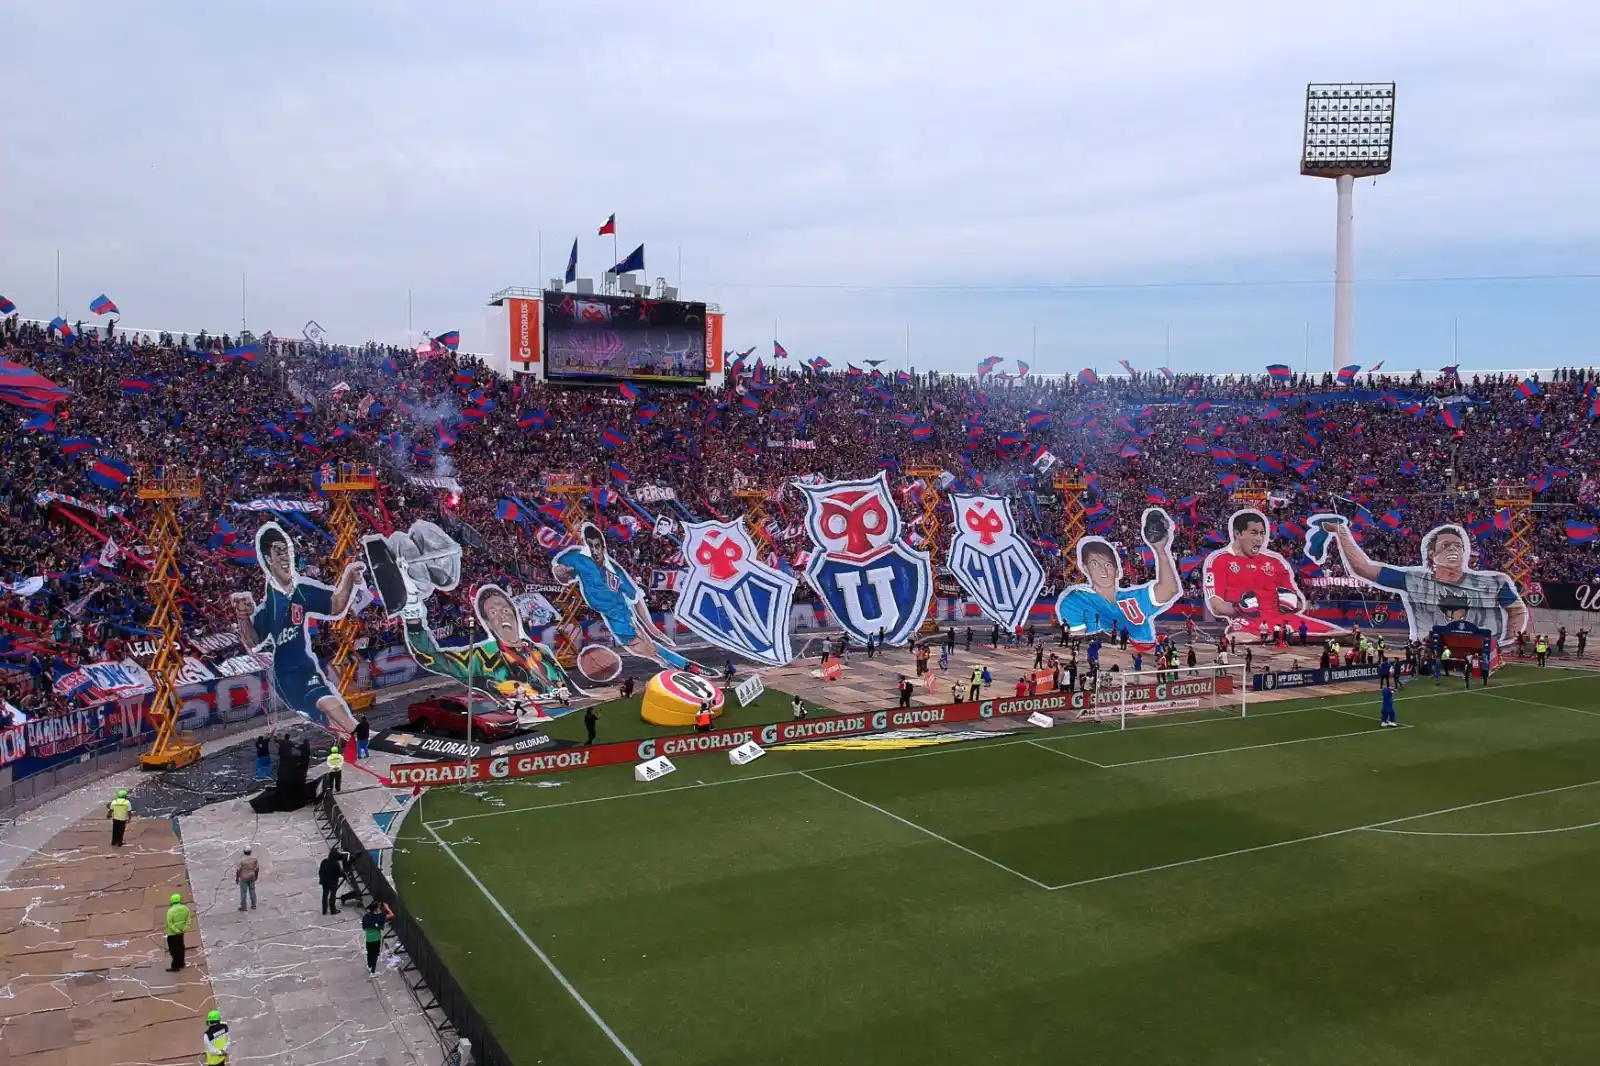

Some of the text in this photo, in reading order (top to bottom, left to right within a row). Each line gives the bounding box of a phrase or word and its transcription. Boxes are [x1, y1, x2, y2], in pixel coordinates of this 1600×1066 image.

[520, 302, 529, 347] GATORADE
[606, 570, 620, 592] U
[835, 566, 899, 636] U
[1116, 598, 1145, 625] U
[291, 603, 304, 625] U
[999, 696, 1066, 713] GATORADE
[784, 717, 865, 739] GATORADE
[421, 739, 480, 757] COLORADO
[515, 735, 549, 751] COLORADO
[664, 731, 753, 754] GATORADE
